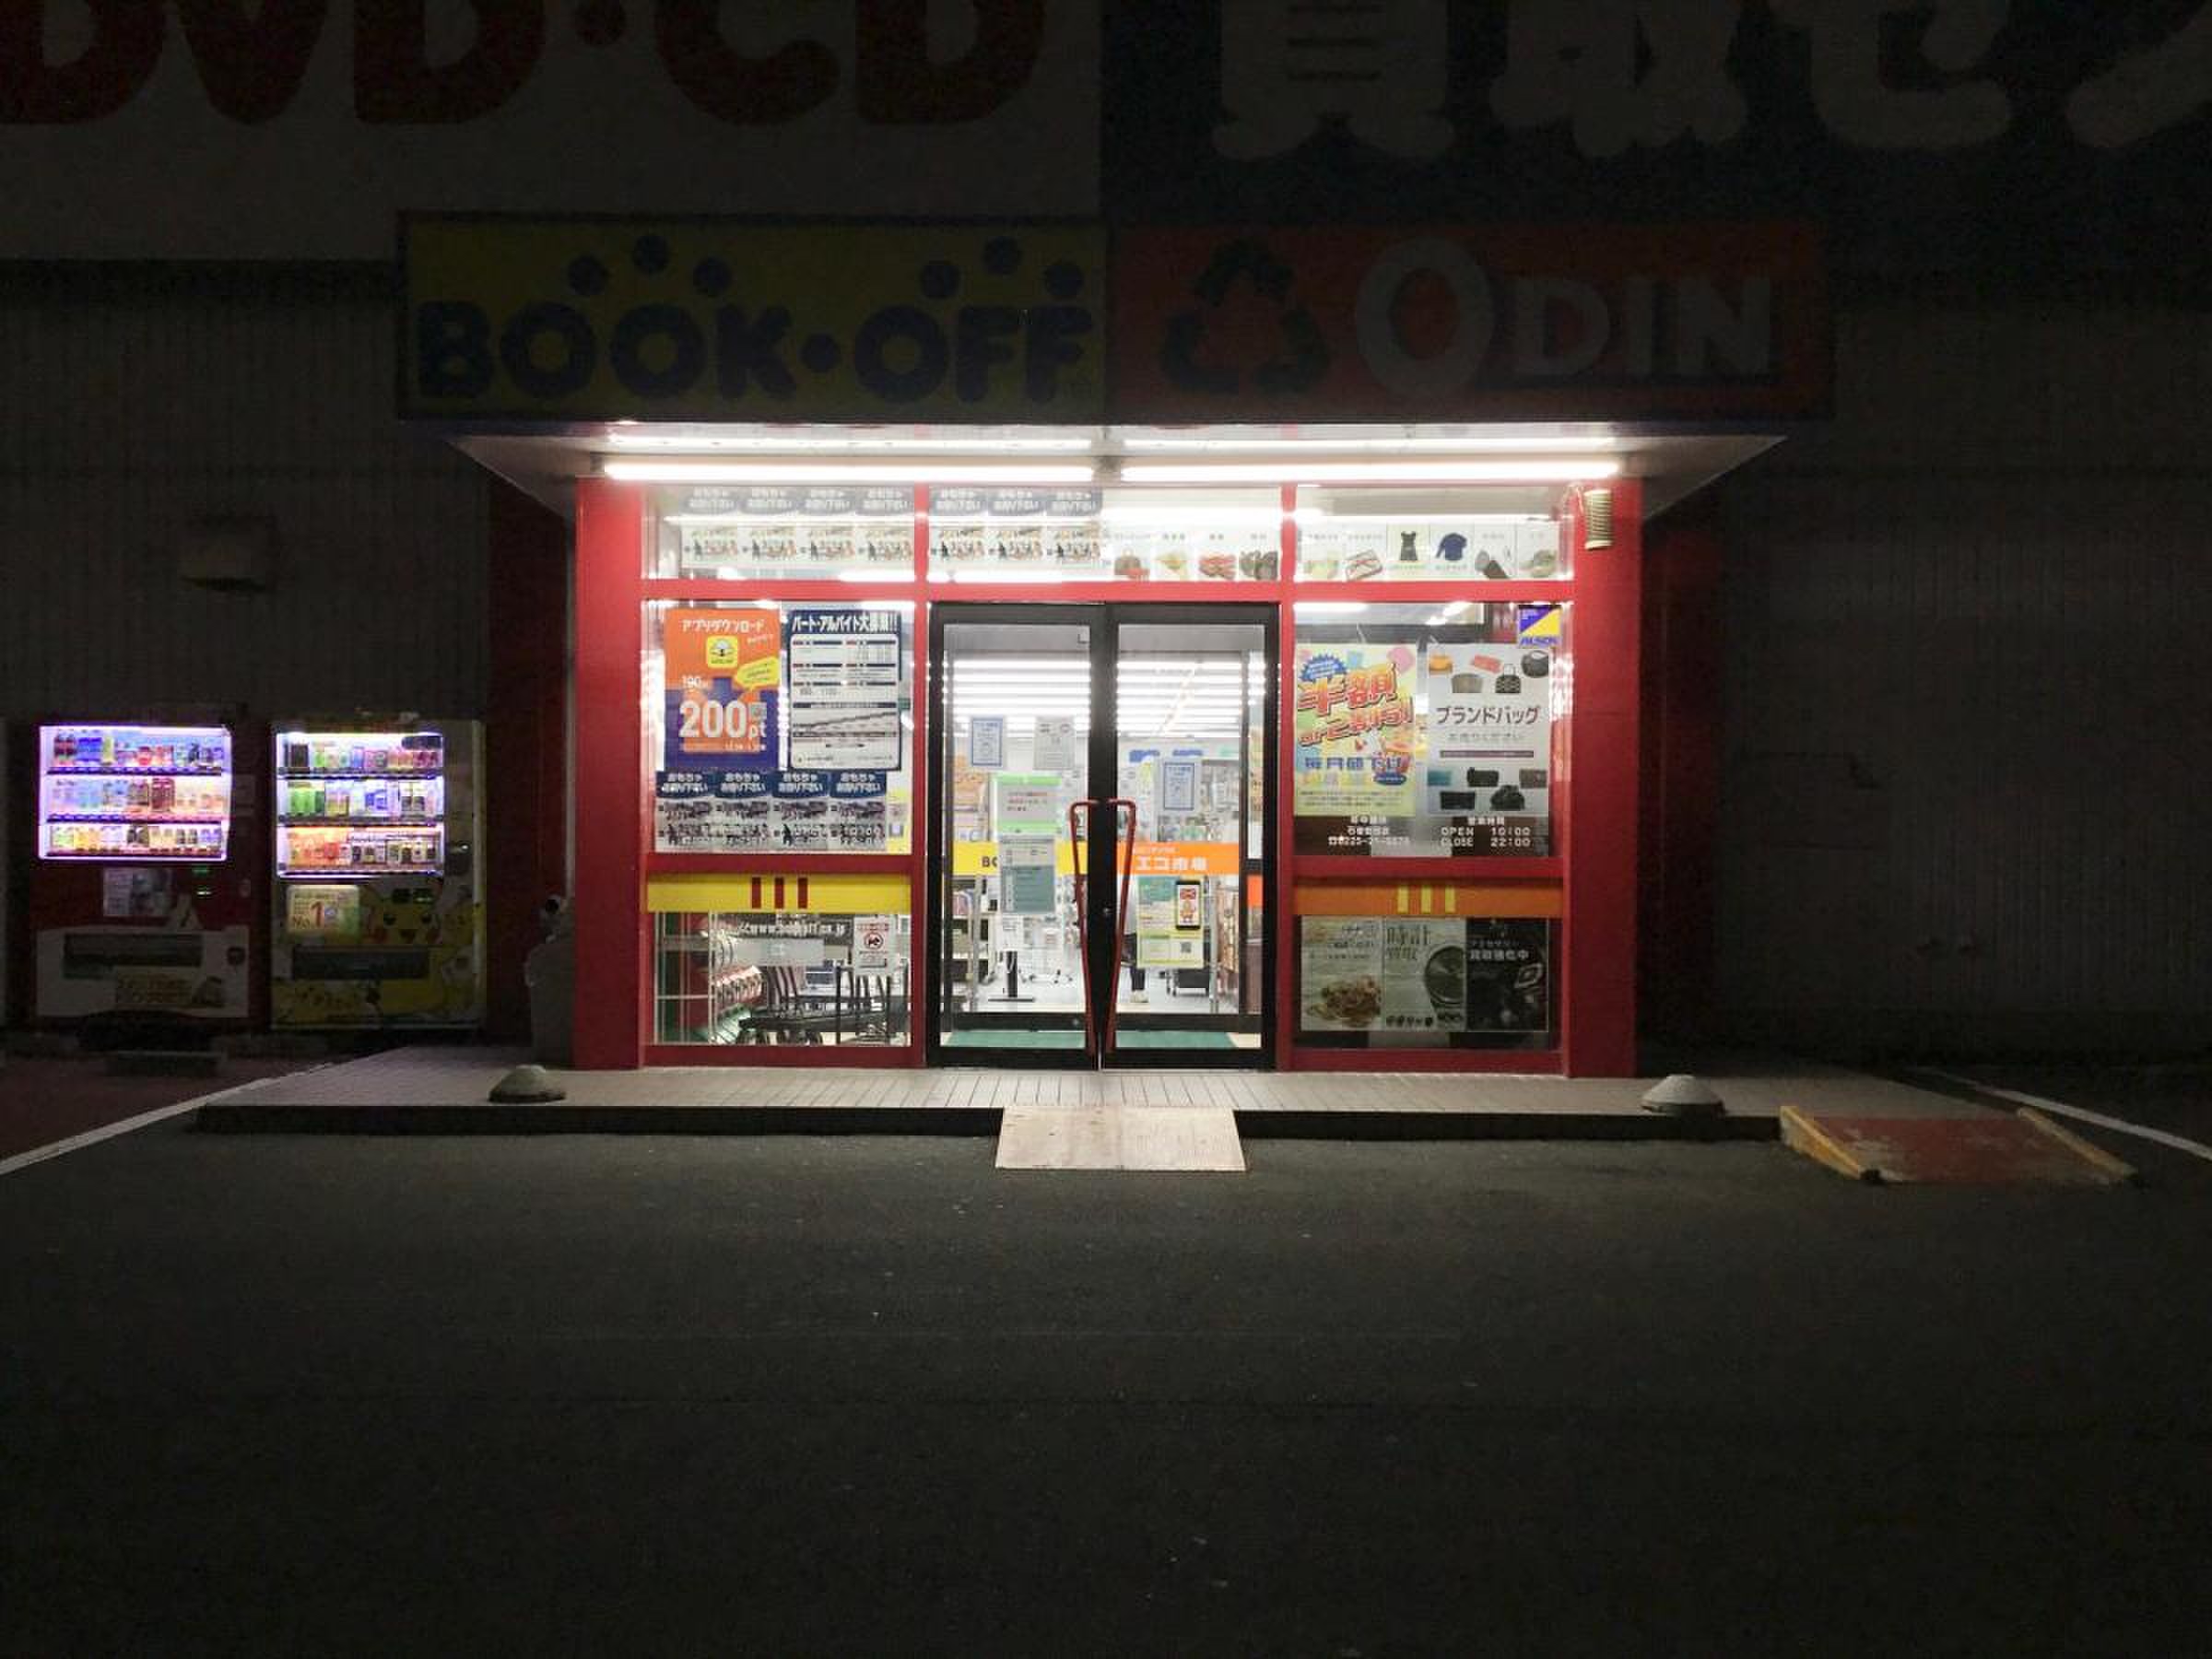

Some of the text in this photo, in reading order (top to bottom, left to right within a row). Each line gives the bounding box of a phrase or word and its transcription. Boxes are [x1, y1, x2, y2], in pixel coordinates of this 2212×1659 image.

[1355, 235, 1773, 400] ODIN
[679, 700, 747, 738] 200
[1436, 705, 1541, 724] ブランドバッグ
[1441, 826, 1532, 836] OPEN 10:00
[1441, 837, 1532, 847] CLOSE 22:00
